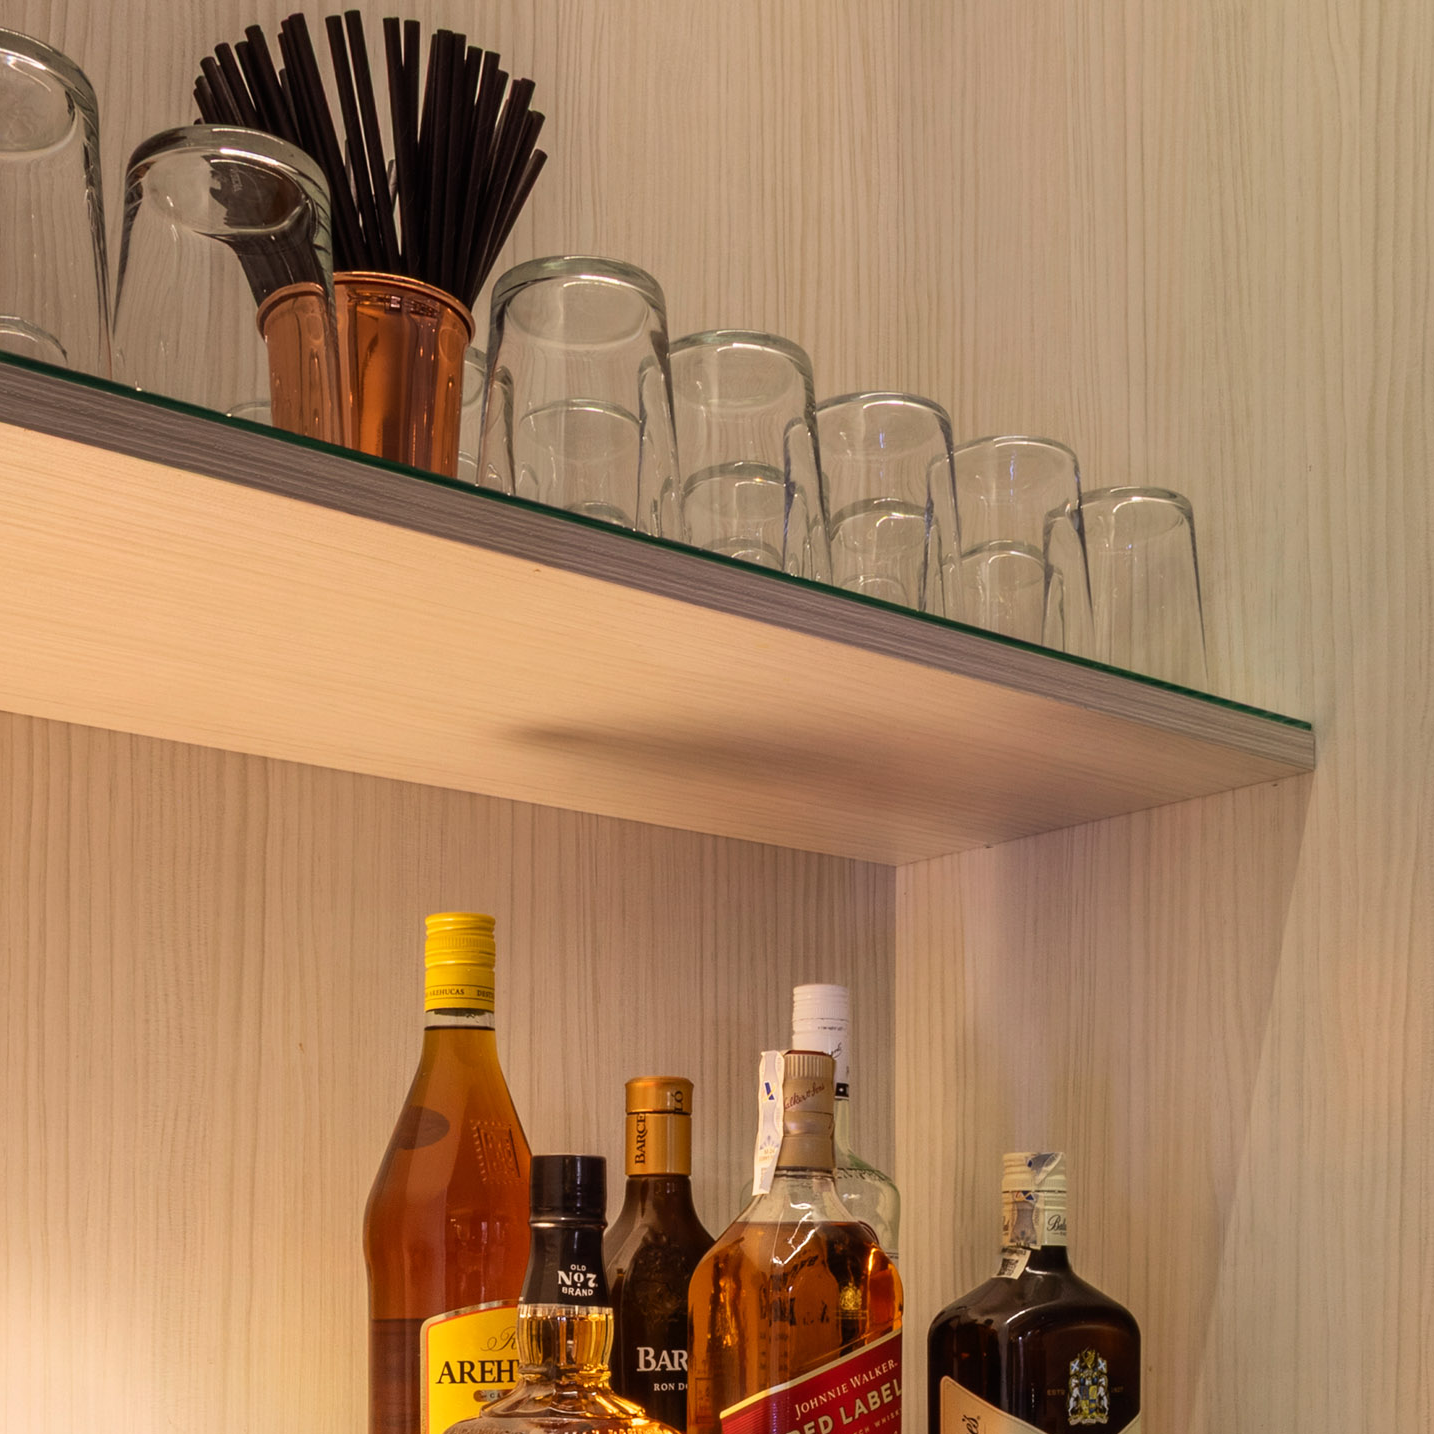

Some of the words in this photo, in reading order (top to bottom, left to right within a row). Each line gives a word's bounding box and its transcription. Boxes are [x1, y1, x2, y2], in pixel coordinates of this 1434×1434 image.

[561, 1287, 594, 1297] BRAND
[653, 1383, 675, 1391] RON
[795, 1383, 849, 1420] JOHNNIE
[849, 1359, 896, 1389] WALKER
[839, 1378, 902, 1425] LABEL
